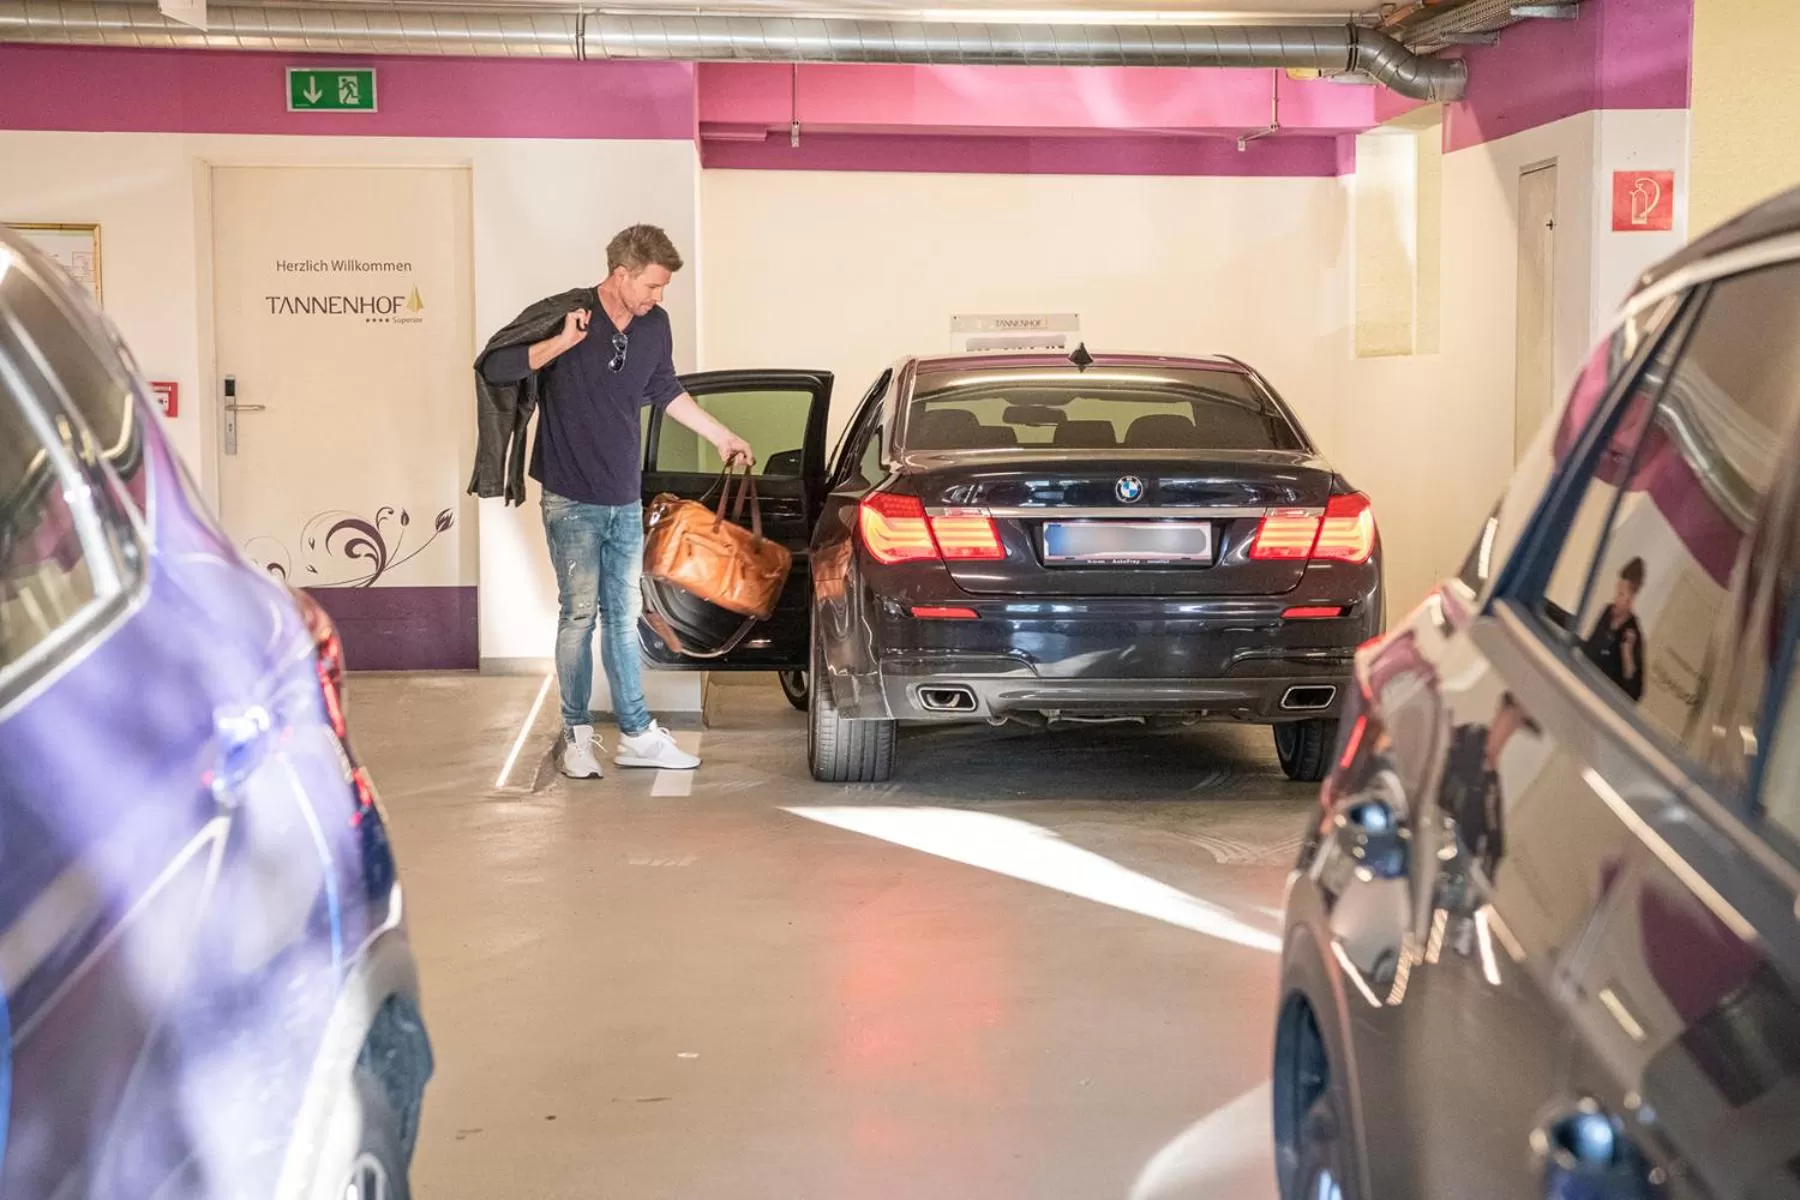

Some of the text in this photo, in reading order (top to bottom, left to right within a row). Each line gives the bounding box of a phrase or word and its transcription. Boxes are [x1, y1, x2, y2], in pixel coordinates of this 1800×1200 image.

[276, 260, 412, 272] Herzlich Willkommen
[265, 296, 405, 314] TANNENHOF
